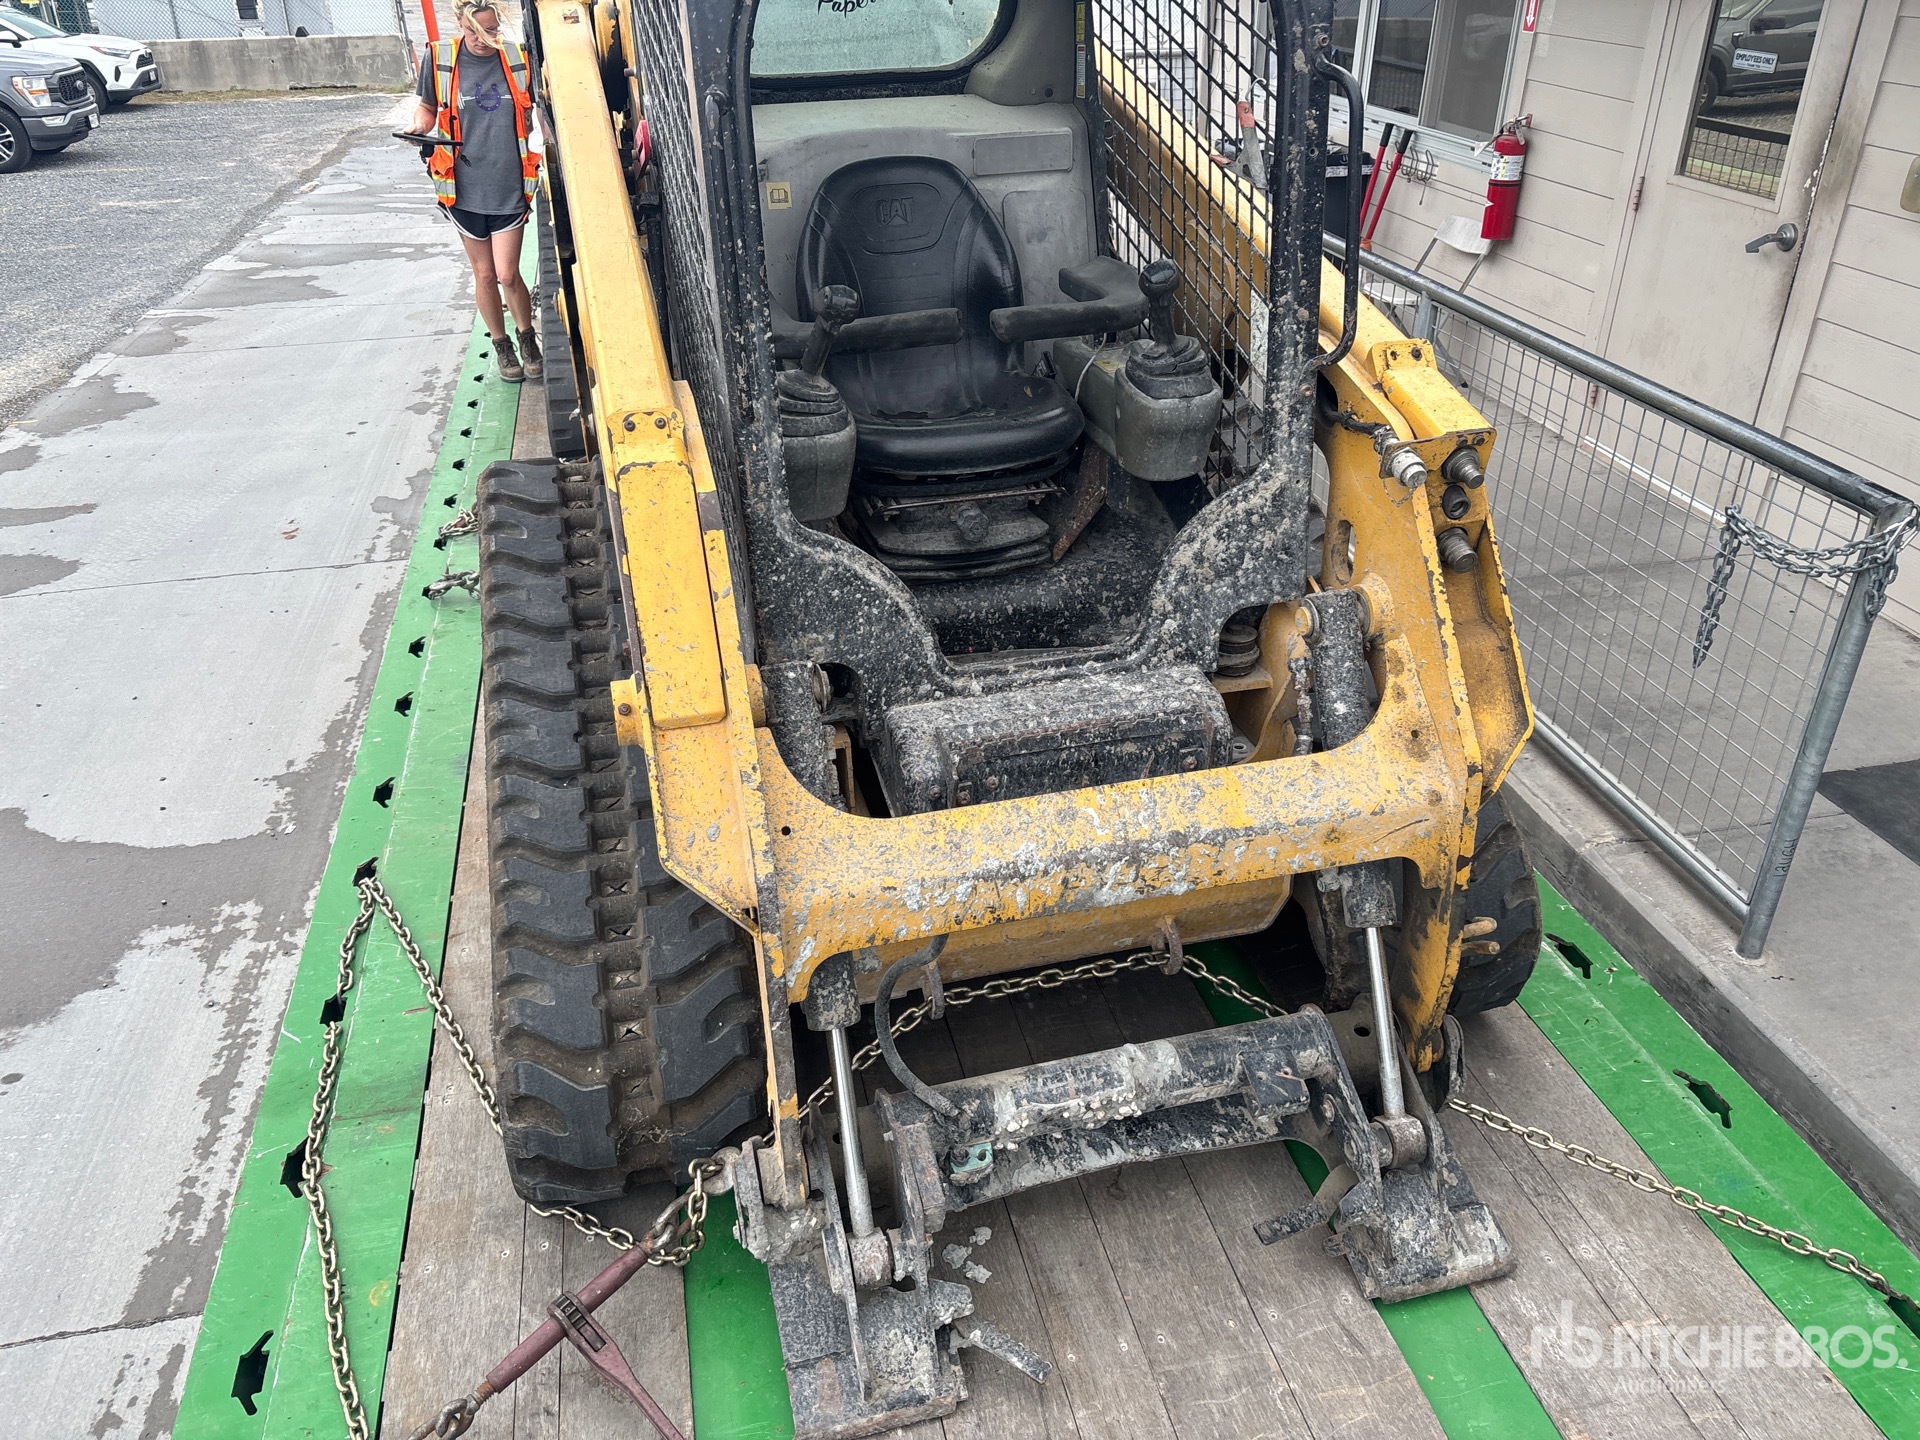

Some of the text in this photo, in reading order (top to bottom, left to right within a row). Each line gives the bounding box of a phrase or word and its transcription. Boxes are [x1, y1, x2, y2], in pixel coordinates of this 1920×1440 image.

[817, 0, 877, 19] Pape
[1735, 53, 1776, 65] EMPLOYEES ONLY
[875, 197, 914, 226] CAT
